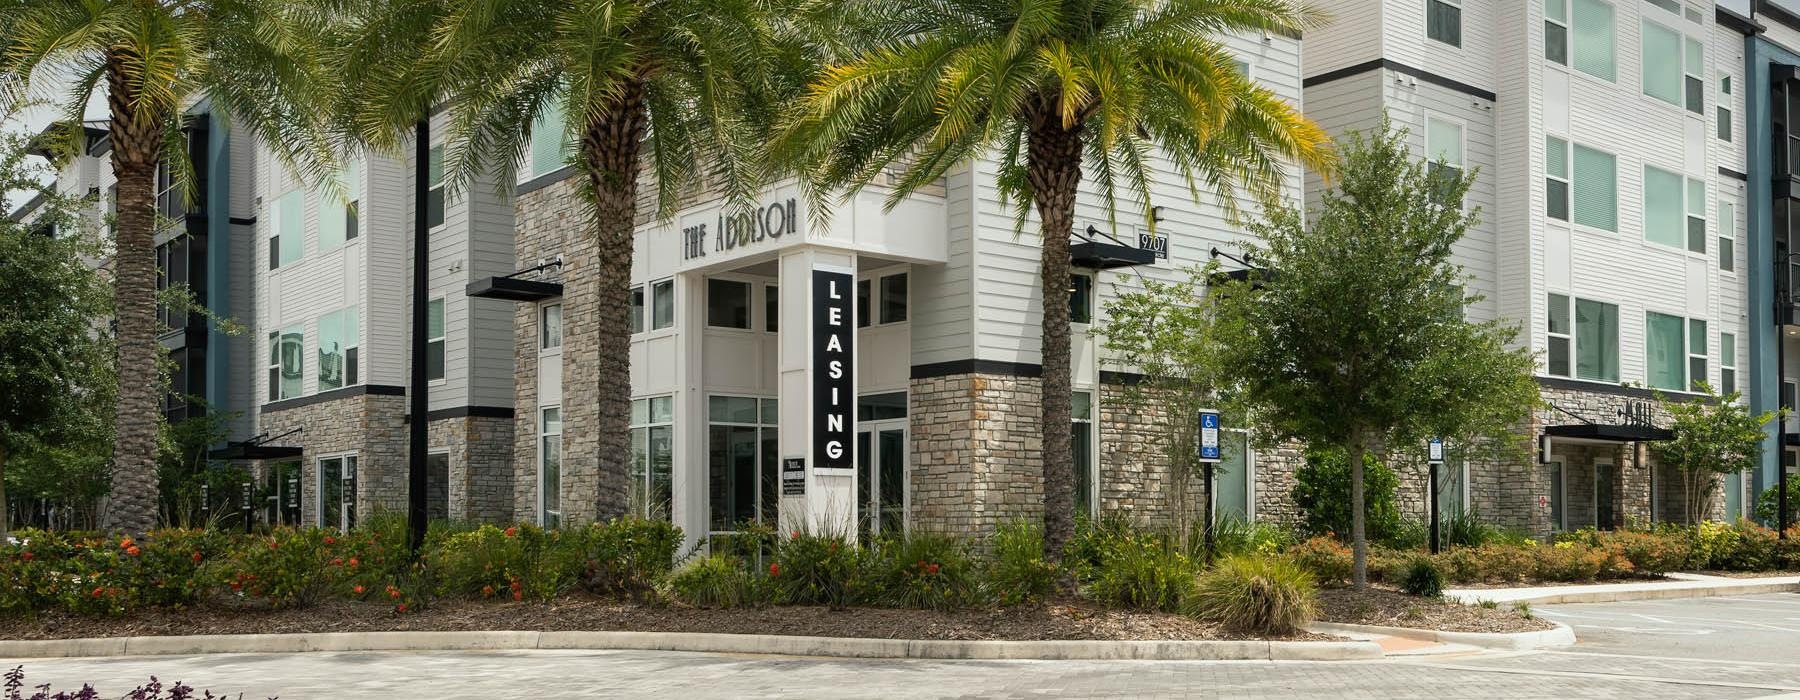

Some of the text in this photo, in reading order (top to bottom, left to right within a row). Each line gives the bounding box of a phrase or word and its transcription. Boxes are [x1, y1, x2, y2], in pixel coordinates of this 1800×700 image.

[683, 198, 796, 260] THE ADDISON
[1142, 234, 1165, 252] 9707
[826, 280, 843, 459] LEASING
